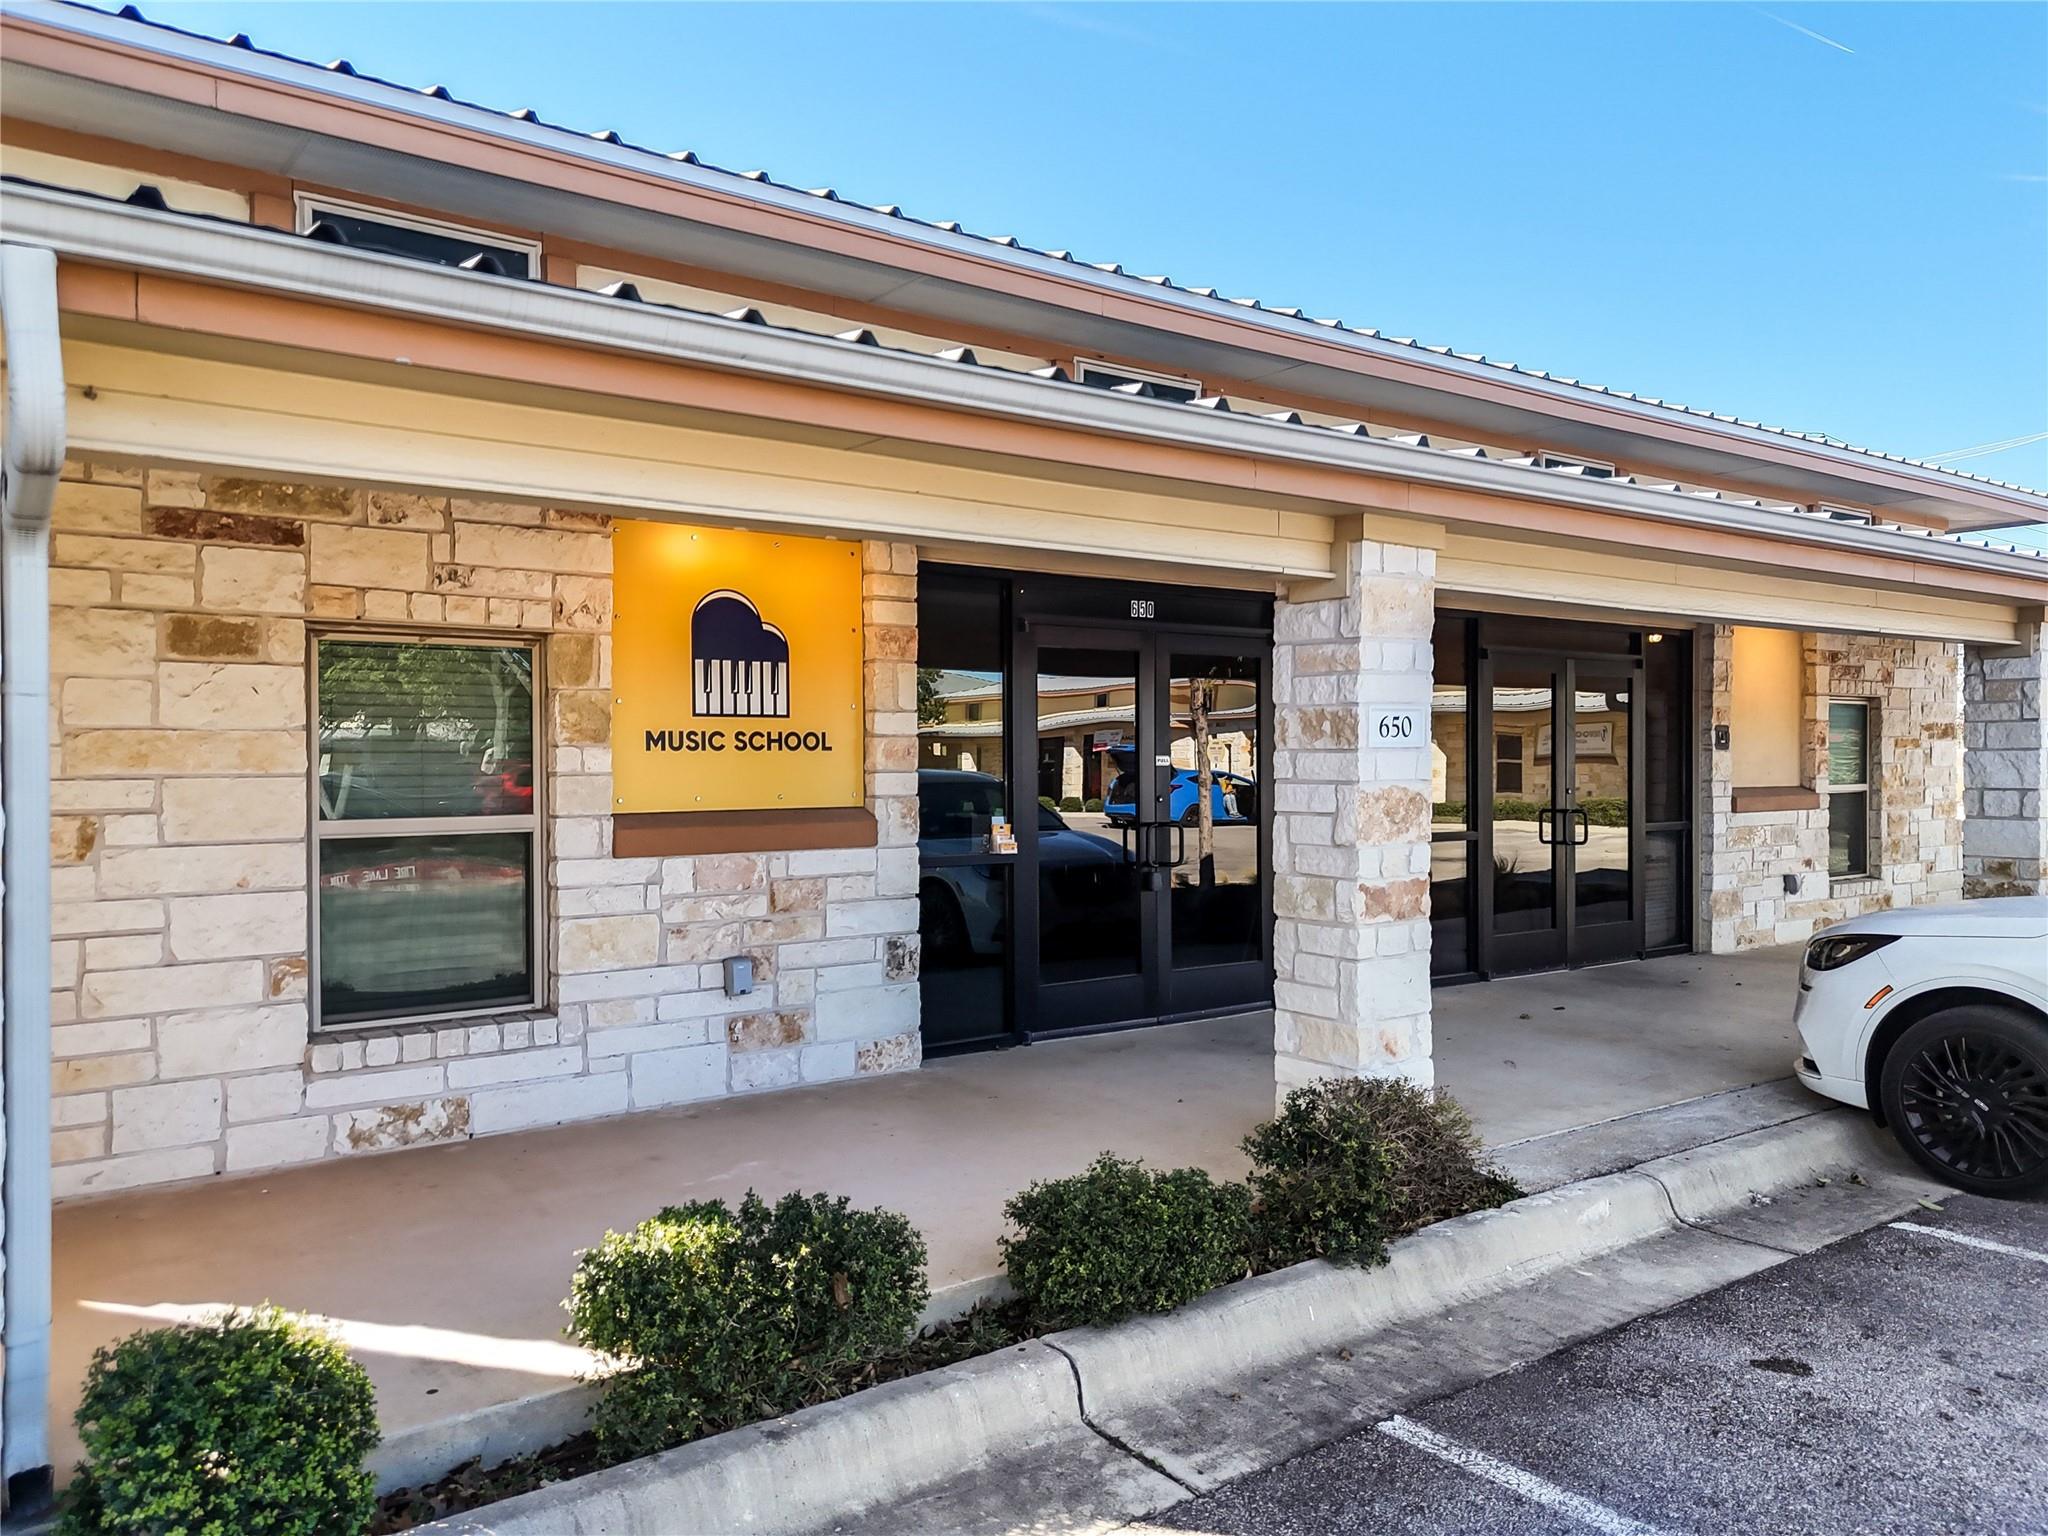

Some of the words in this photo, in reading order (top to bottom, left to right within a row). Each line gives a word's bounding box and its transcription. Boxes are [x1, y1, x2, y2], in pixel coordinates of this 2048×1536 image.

[1131, 600, 1154, 618] 650
[1379, 715, 1412, 738] 650
[645, 730, 726, 752] MUSIC
[734, 731, 833, 752] SCHOOL
